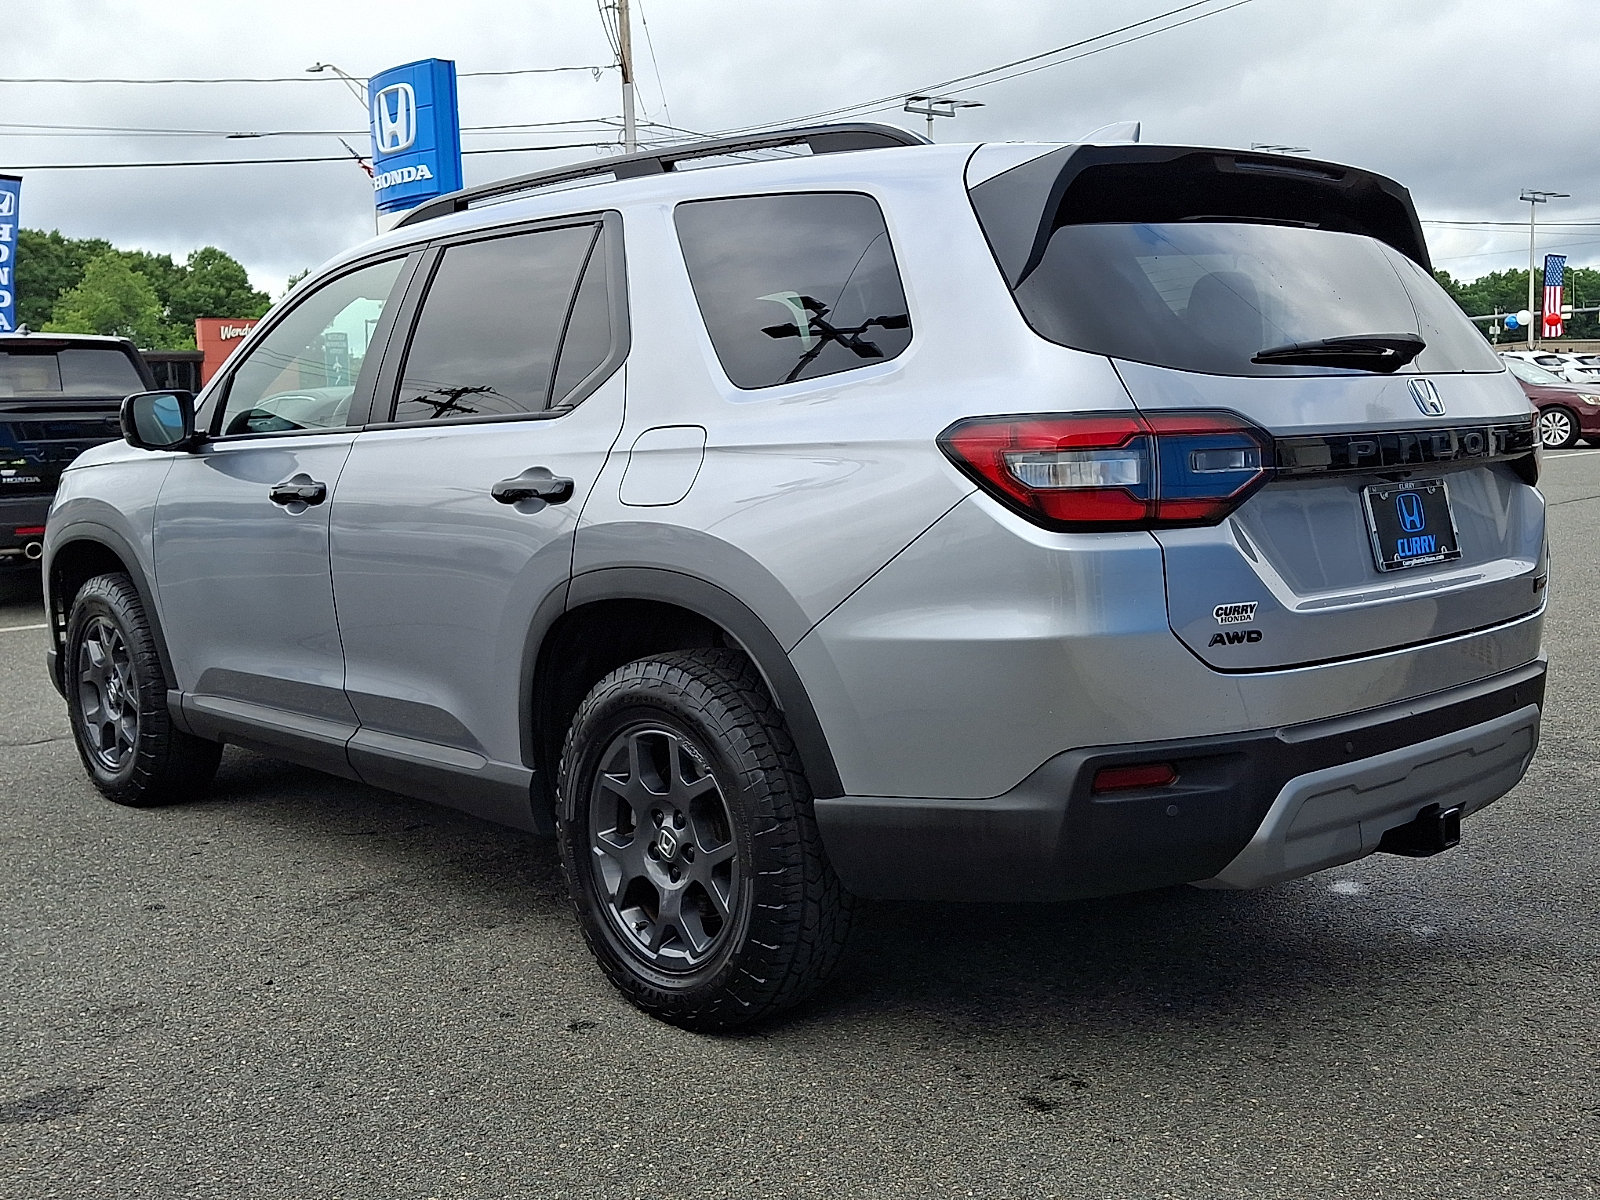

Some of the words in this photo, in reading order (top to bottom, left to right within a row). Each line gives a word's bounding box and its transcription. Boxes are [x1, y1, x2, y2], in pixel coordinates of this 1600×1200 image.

[374, 164, 434, 191] HONDA
[1348, 429, 1510, 466] PILOT
[1397, 534, 1436, 557] CURRY
[1215, 603, 1257, 618] CURRY
[1220, 614, 1252, 624] HONDA
[1208, 630, 1263, 648] AWD
